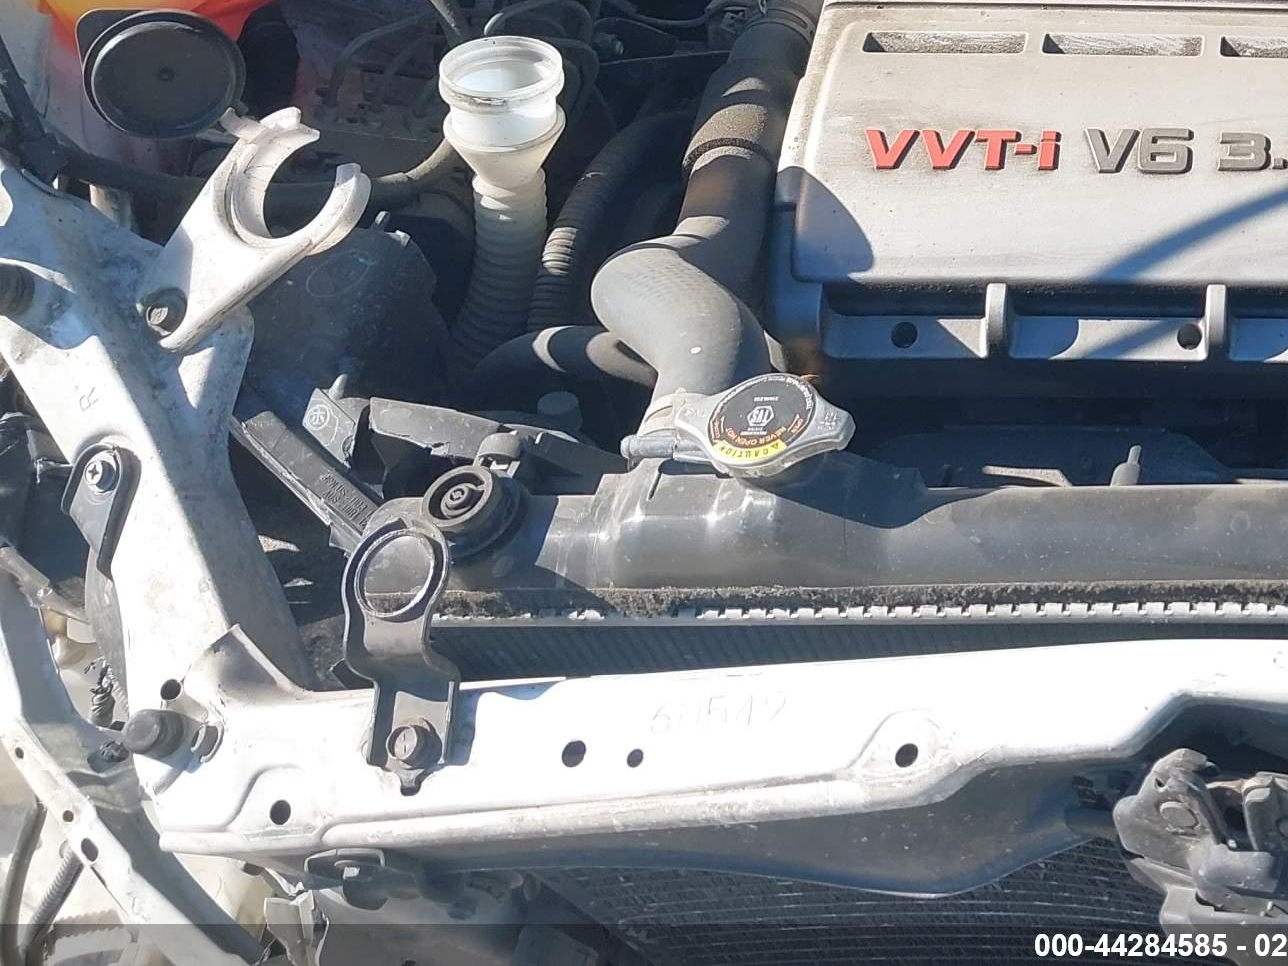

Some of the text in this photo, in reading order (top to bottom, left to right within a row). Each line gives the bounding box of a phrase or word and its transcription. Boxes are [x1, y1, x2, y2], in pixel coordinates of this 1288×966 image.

[865, 128, 1062, 171] VVT-i
[1084, 127, 1194, 174] V6
[725, 427, 739, 441] HOT
[736, 436, 758, 446] OPEN
[760, 426, 787, 444] NEVER
[719, 445, 770, 458] CAUTION
